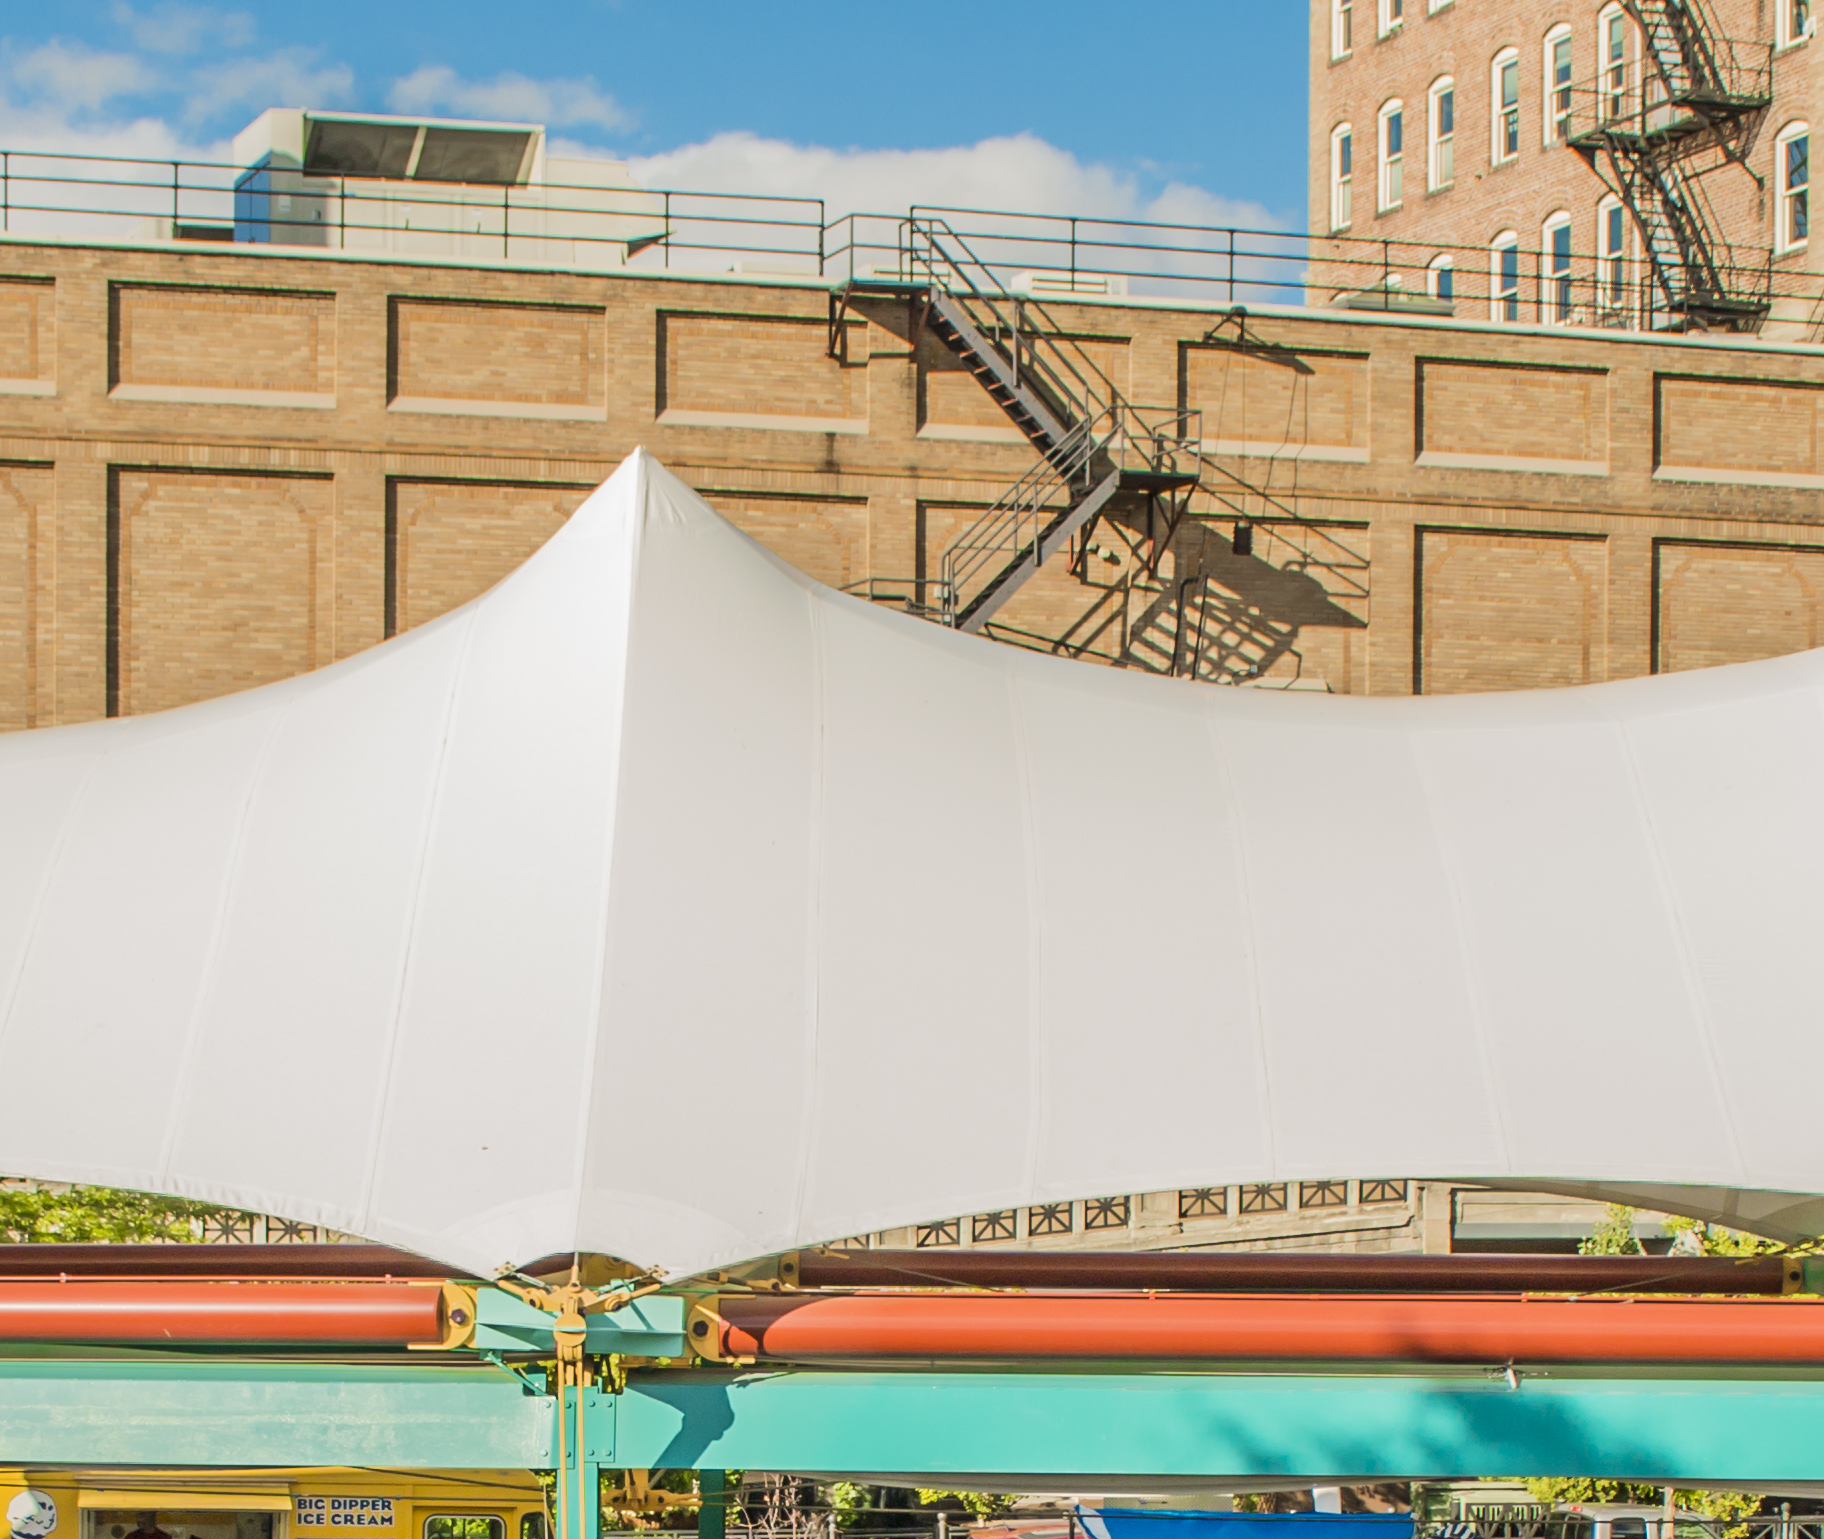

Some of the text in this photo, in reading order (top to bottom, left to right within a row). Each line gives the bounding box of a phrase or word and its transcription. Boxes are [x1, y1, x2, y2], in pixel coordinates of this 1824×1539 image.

[297, 1498, 392, 1511] BIG DIPPER
[297, 1513, 393, 1526] ICE CREAM
